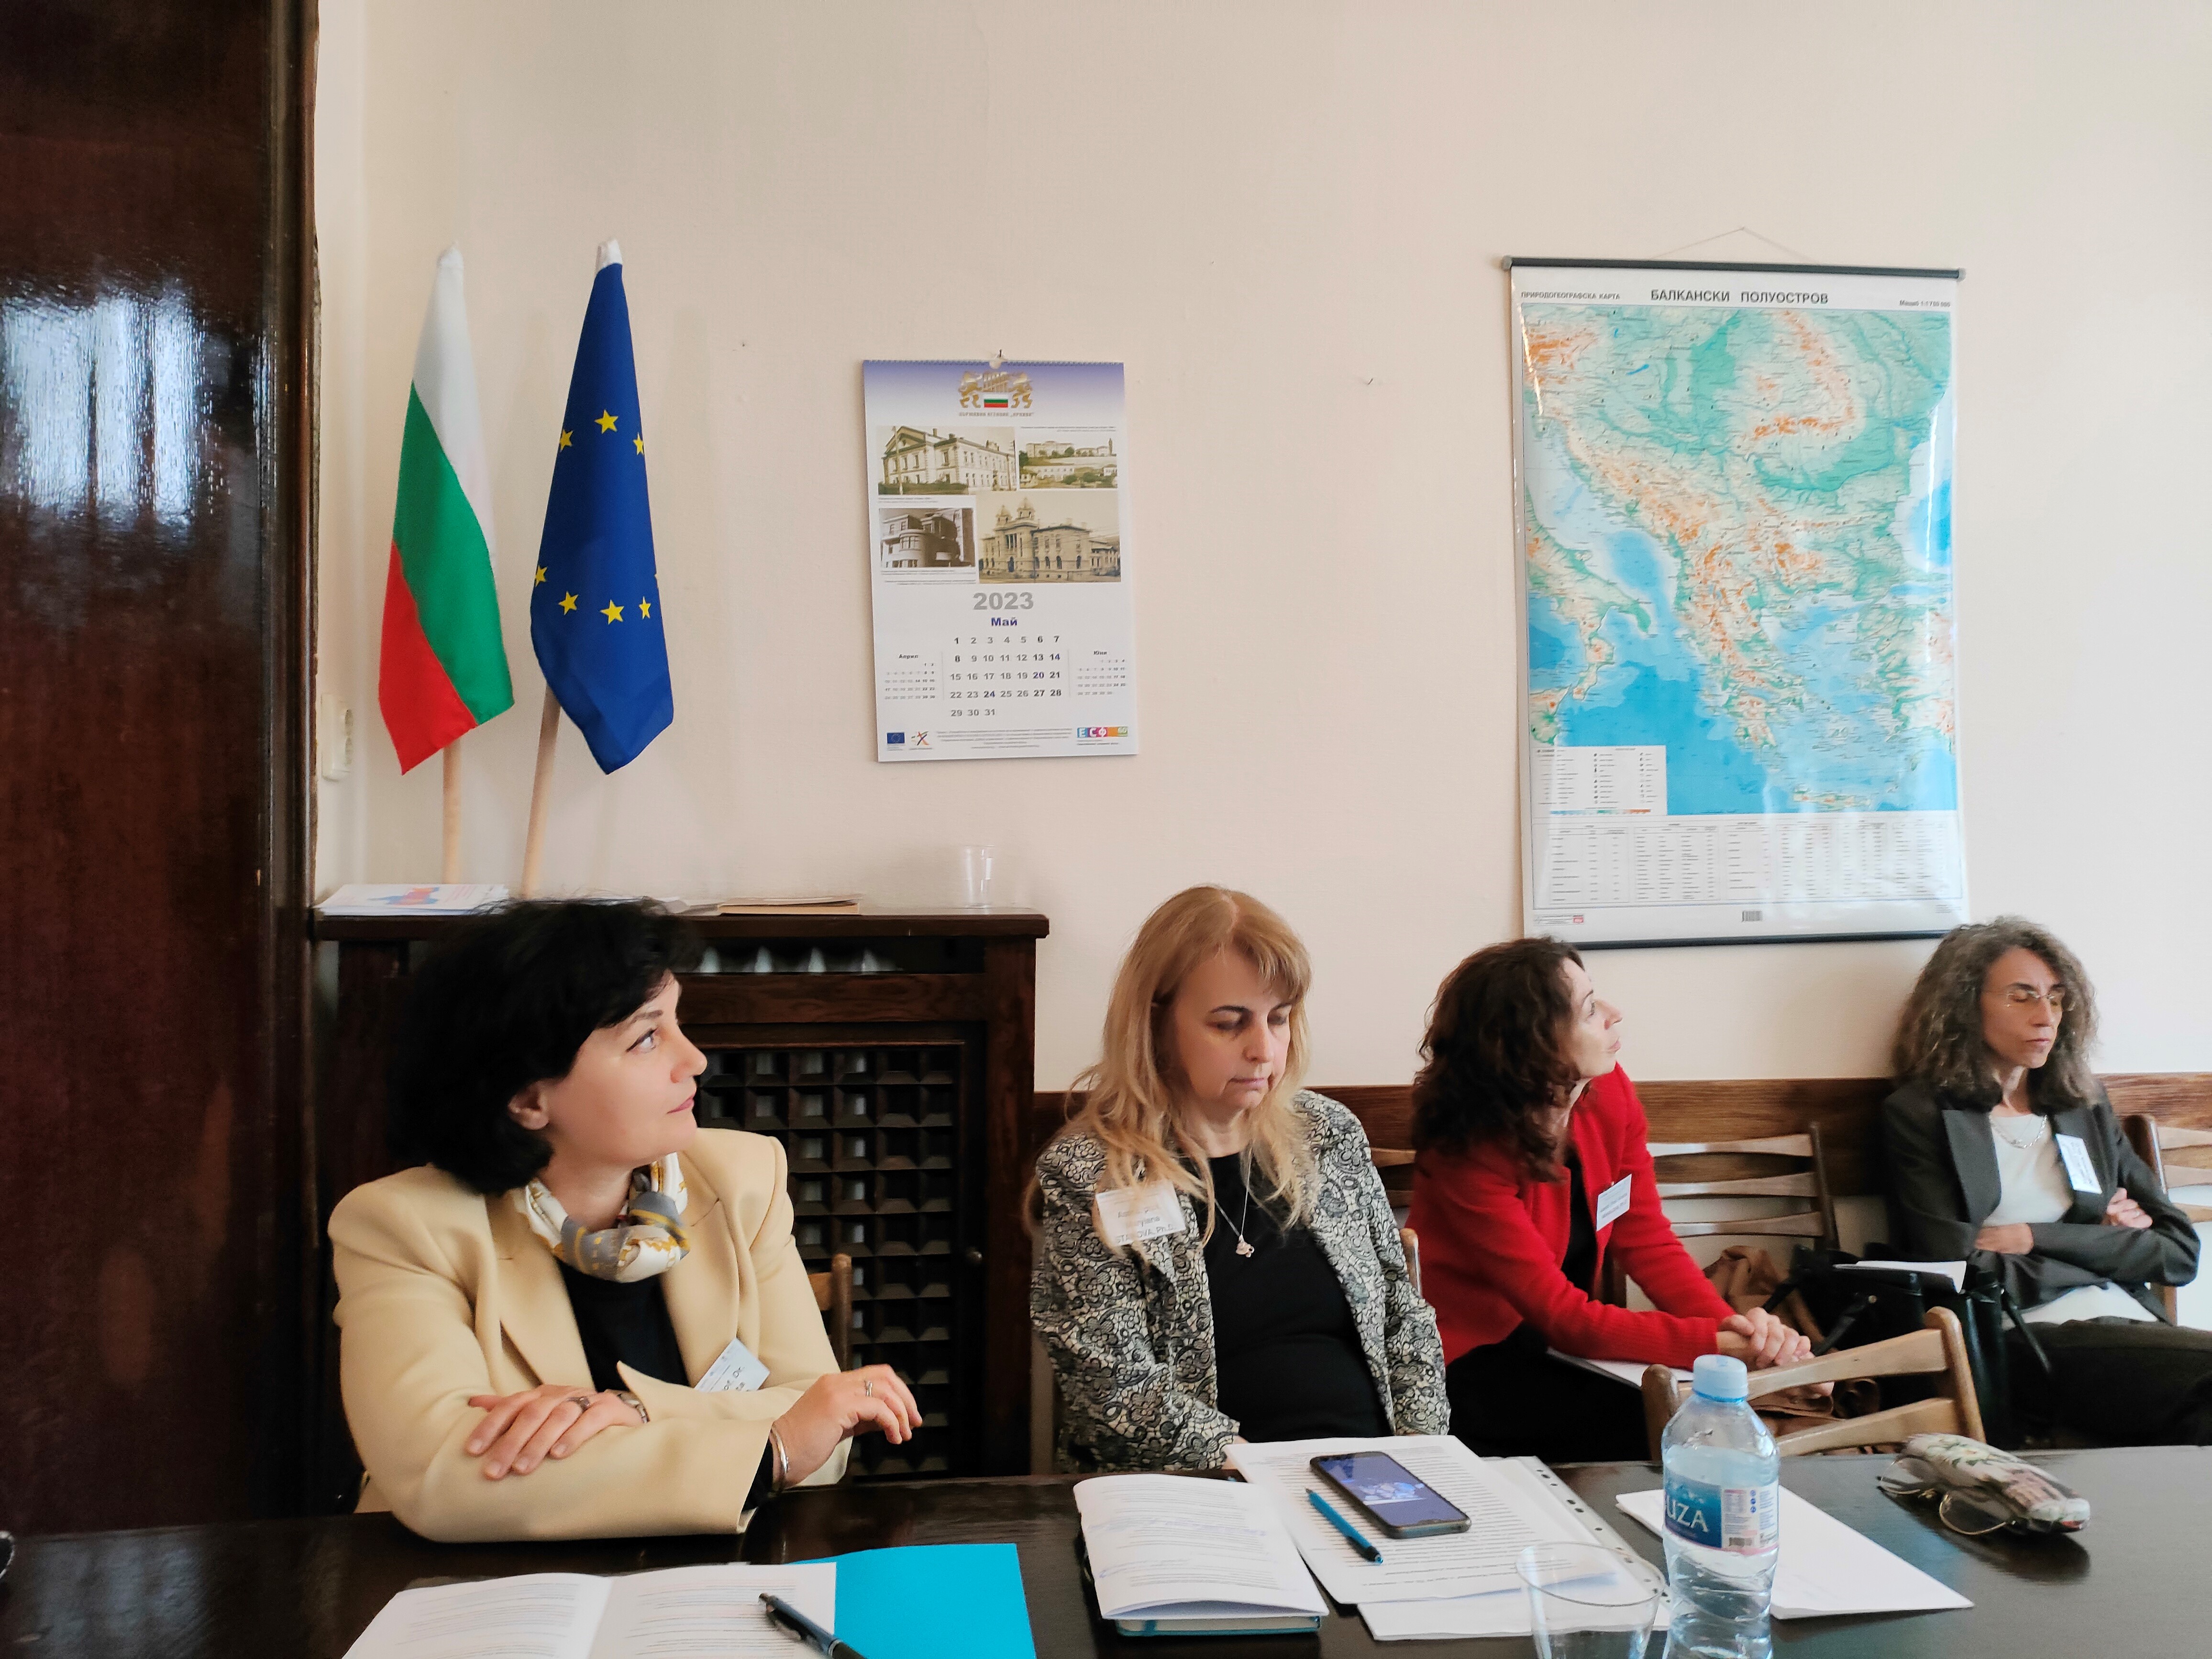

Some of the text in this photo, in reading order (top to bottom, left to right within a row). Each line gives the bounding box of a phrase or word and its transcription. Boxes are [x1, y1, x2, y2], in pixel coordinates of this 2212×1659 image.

[1651, 289, 1828, 304] БАЛКАНСКИ ПОЛУОСТРОВ
[973, 592, 1033, 610] 2023
[991, 617, 1017, 626] Май
